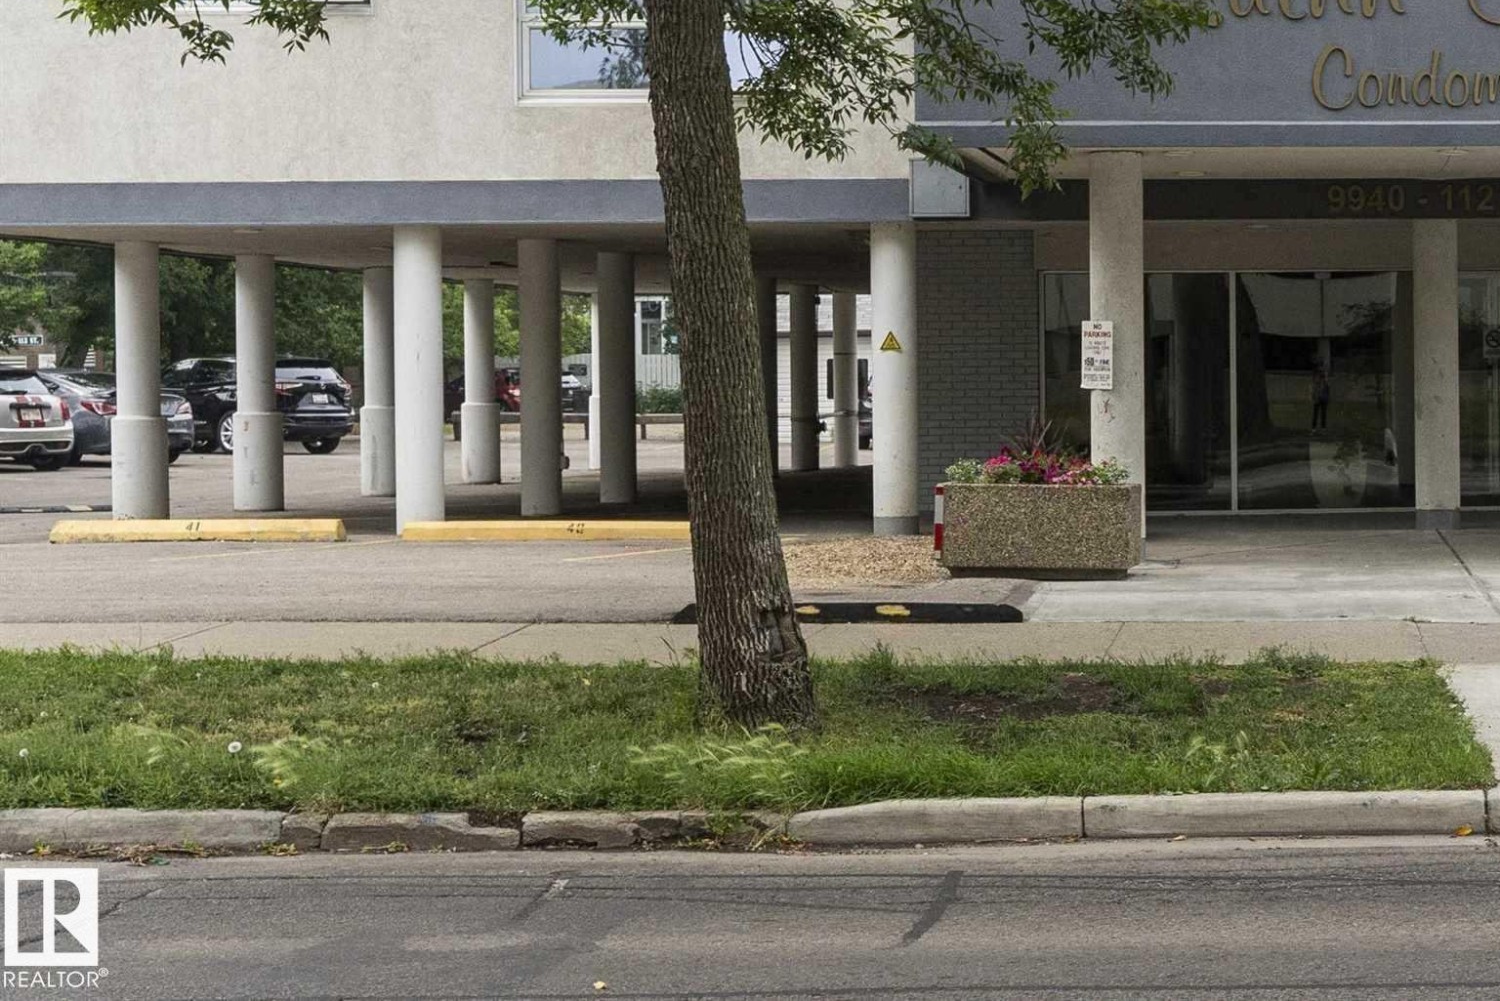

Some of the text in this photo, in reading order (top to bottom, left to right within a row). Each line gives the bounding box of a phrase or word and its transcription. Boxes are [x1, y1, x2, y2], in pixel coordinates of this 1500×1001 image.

[1328, 185, 1405, 210] 9940
[1440, 184, 1494, 211] 112
[185, 521, 200, 532] 41
